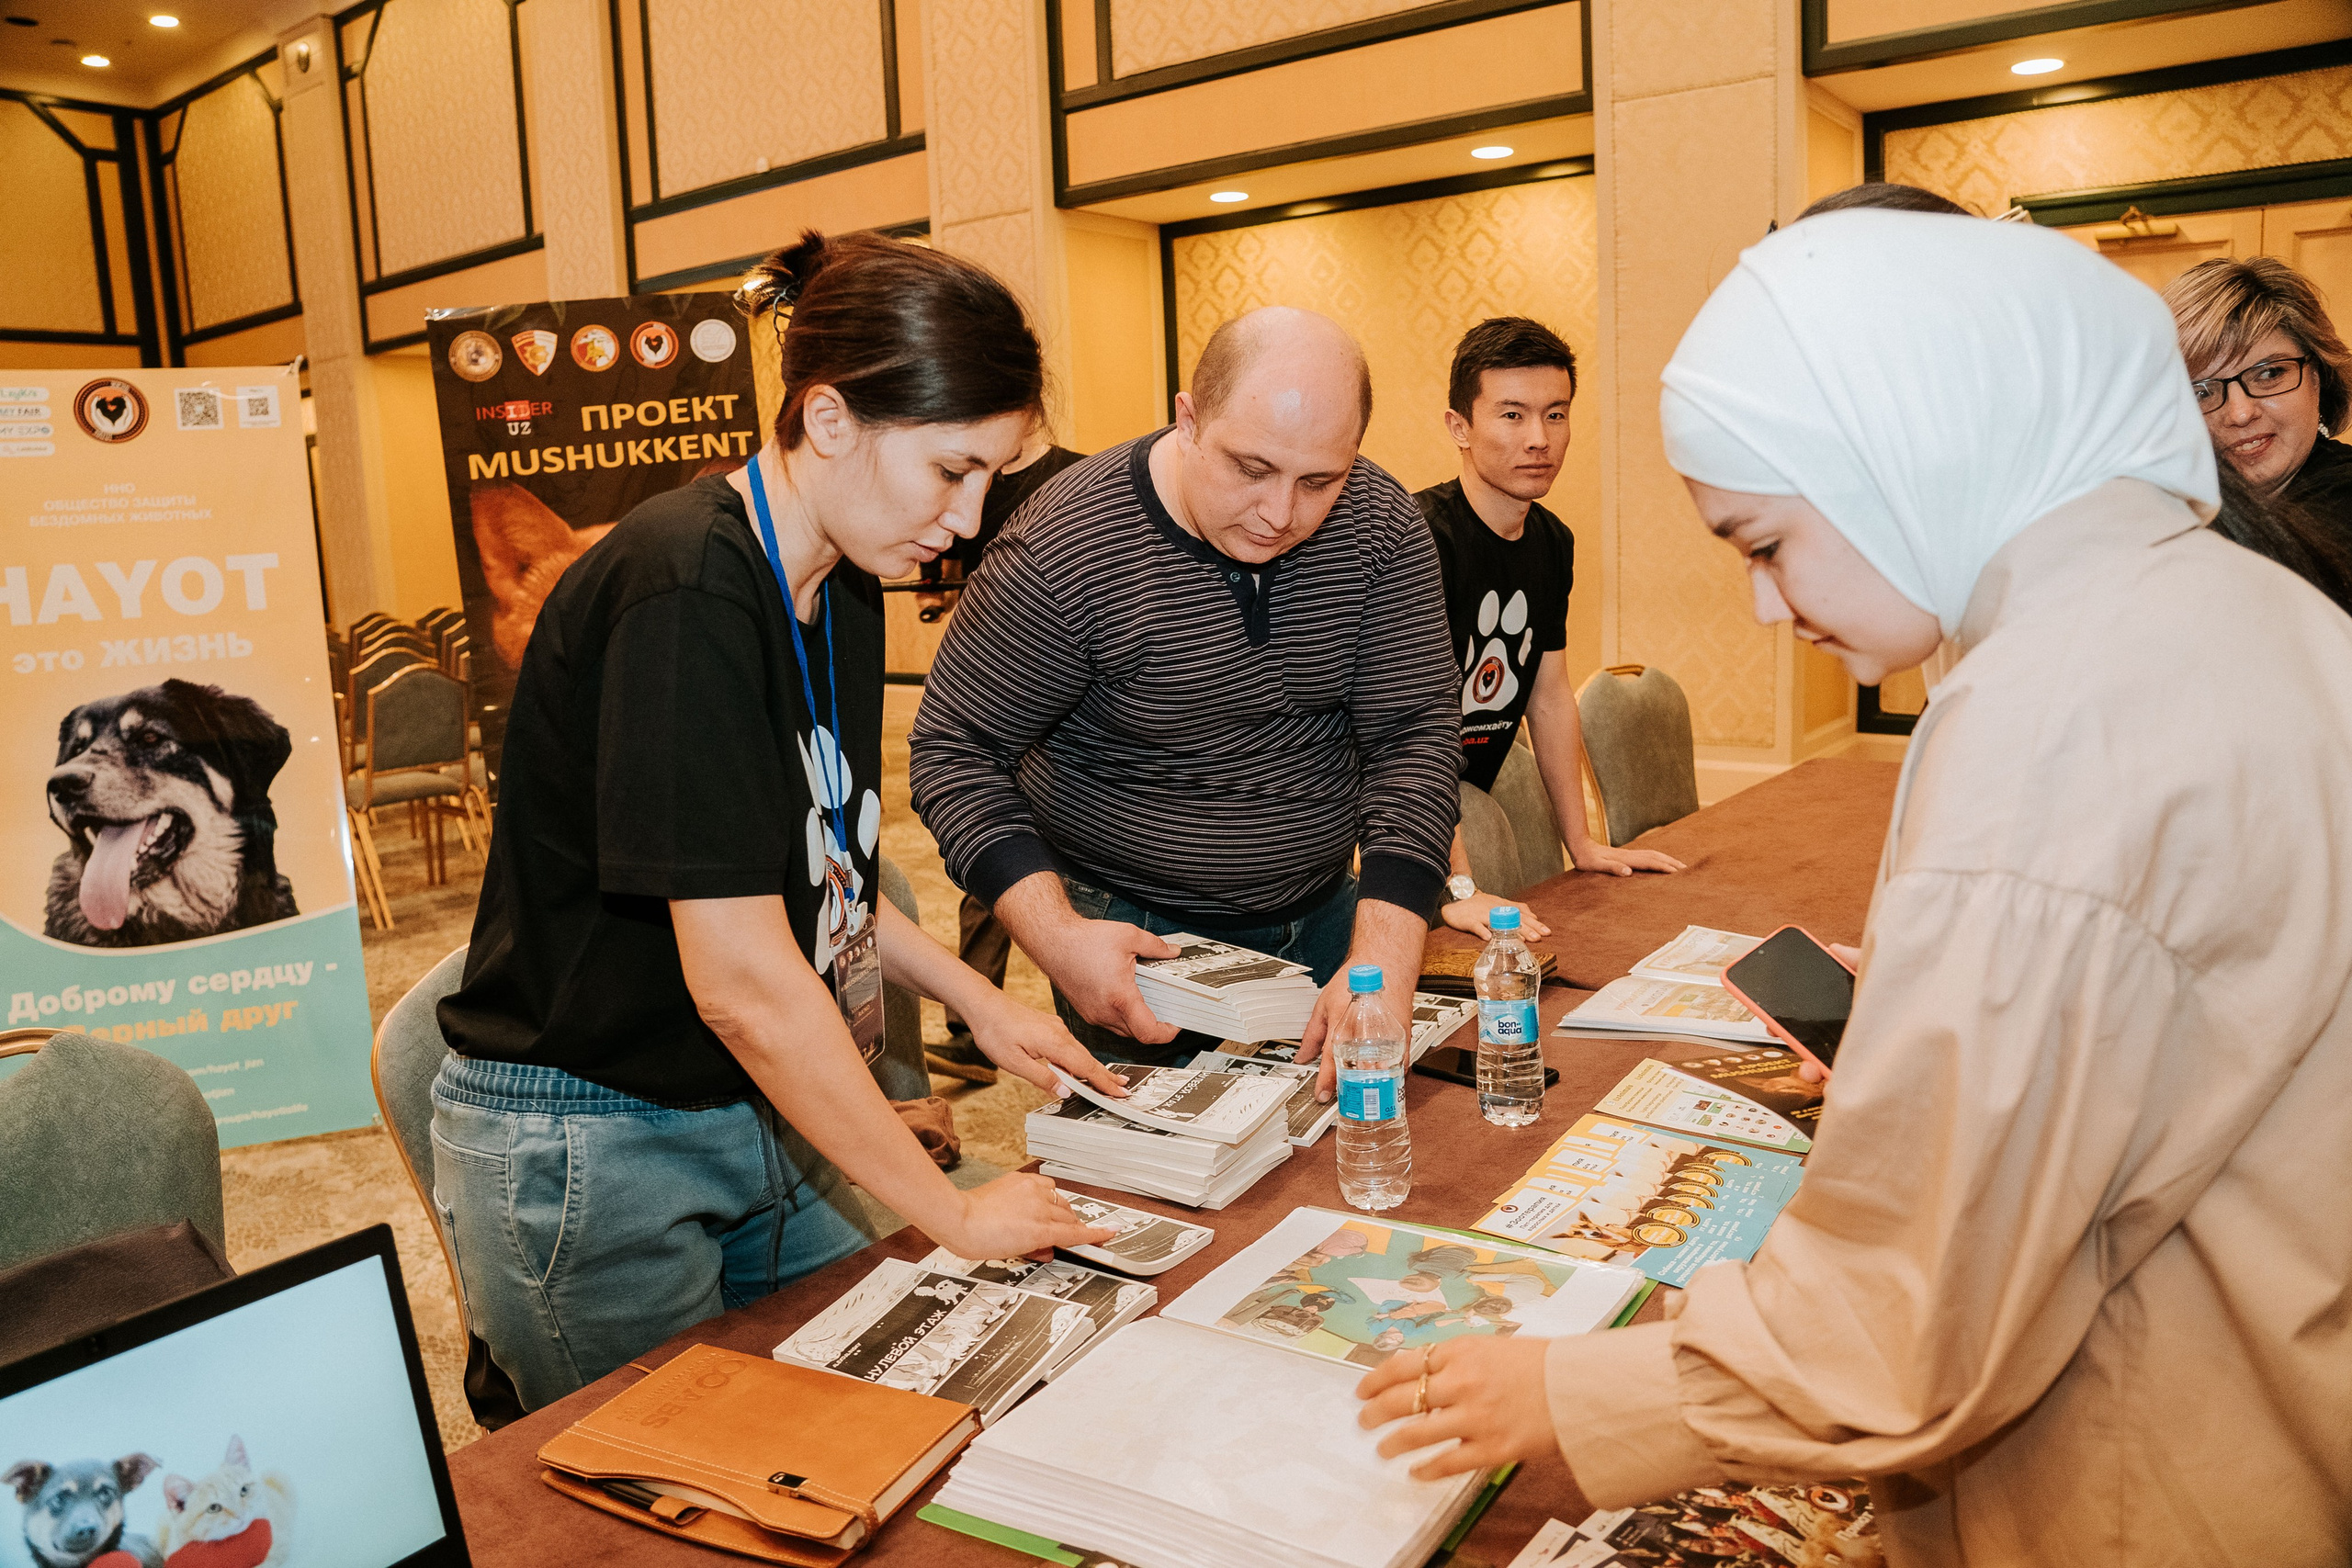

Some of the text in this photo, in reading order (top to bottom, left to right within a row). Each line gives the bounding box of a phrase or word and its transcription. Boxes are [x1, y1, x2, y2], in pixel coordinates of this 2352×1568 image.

[476, 400, 552, 422] INSIDER
[581, 394, 740, 432] ПРОЕКТ
[507, 422, 532, 435] UZ
[469, 431, 753, 480] MUSHUKKENT
[29, 508, 213, 528] БЕЗДОМНЫХ ЖИВОТНЫХ
[43, 495, 197, 512] ОБЩЕСТВО ЗАЩИТЫ
[12, 631, 254, 674] это ЖИЗНЬ
[7, 978, 176, 1025] Доброму
[187, 960, 314, 996] сердцу
[220, 1000, 299, 1033] друг
[1498, 1027, 1522, 1036] aqua
[1505, 1197, 1547, 1228] #Зоотерапия
[864, 1309, 947, 1381] НУЛЕВОЙ ЭТАЖ
